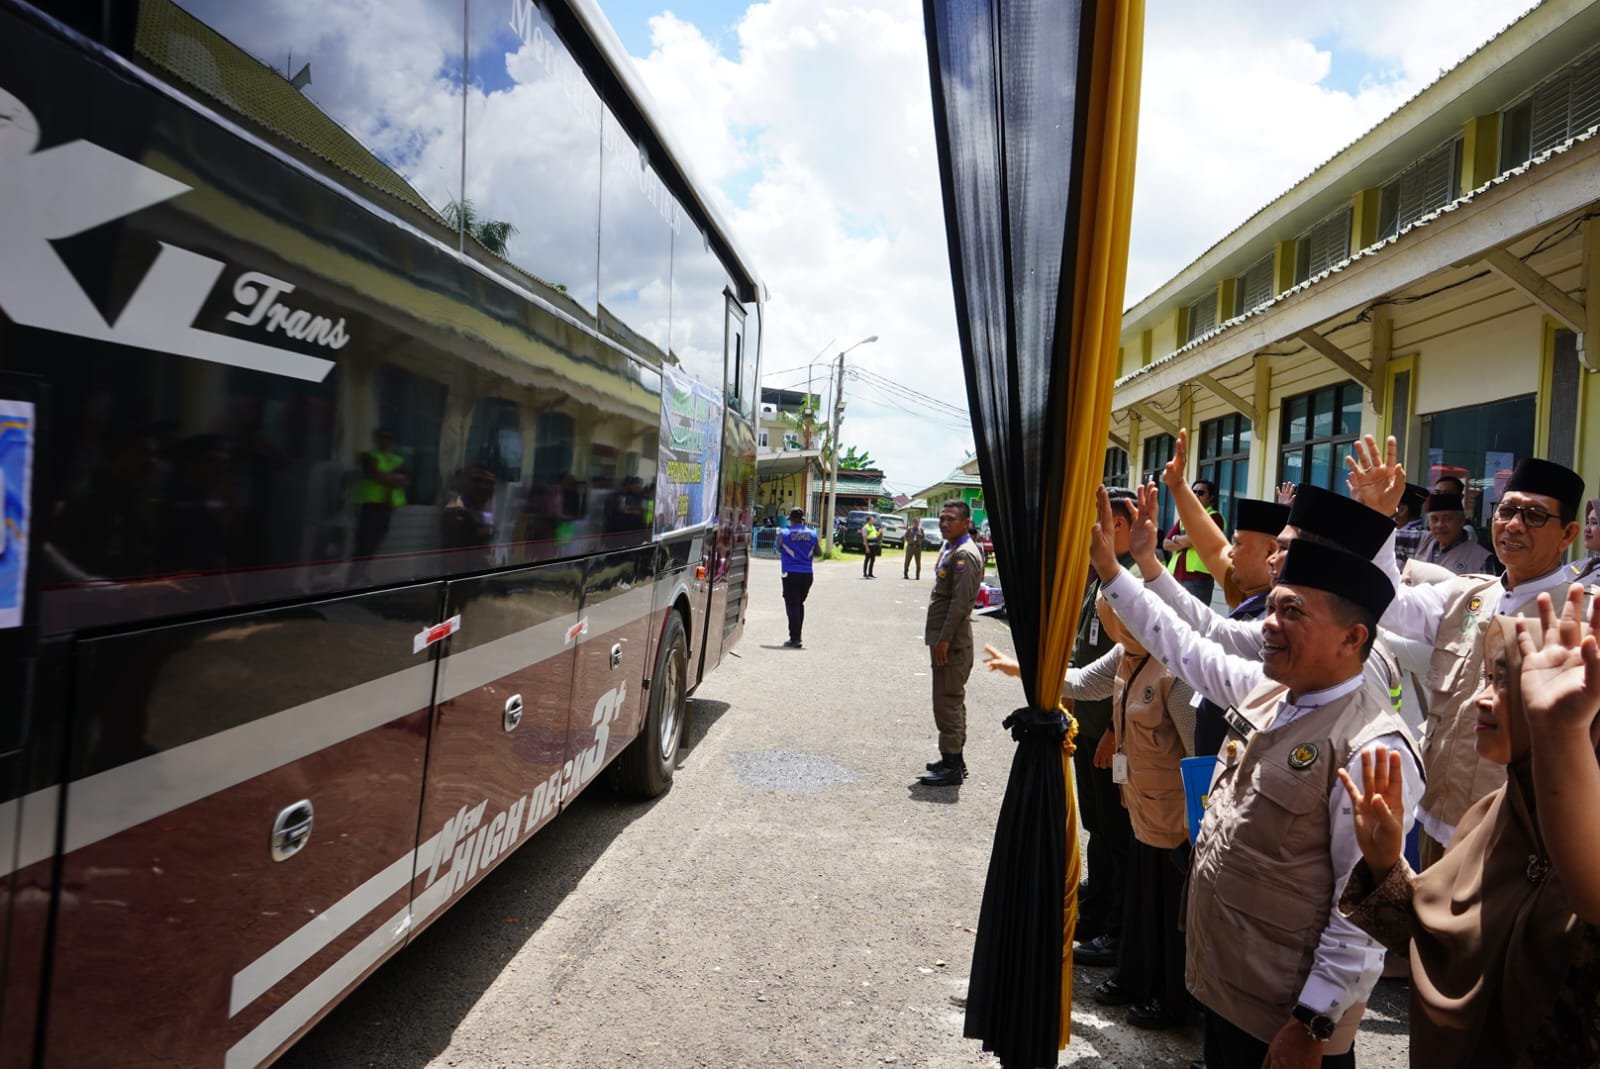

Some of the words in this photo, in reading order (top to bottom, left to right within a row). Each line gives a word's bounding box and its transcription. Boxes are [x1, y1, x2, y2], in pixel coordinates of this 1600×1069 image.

[225, 271, 349, 349] Trans
[444, 794, 528, 899] HIGH
[524, 747, 589, 833] DECK
